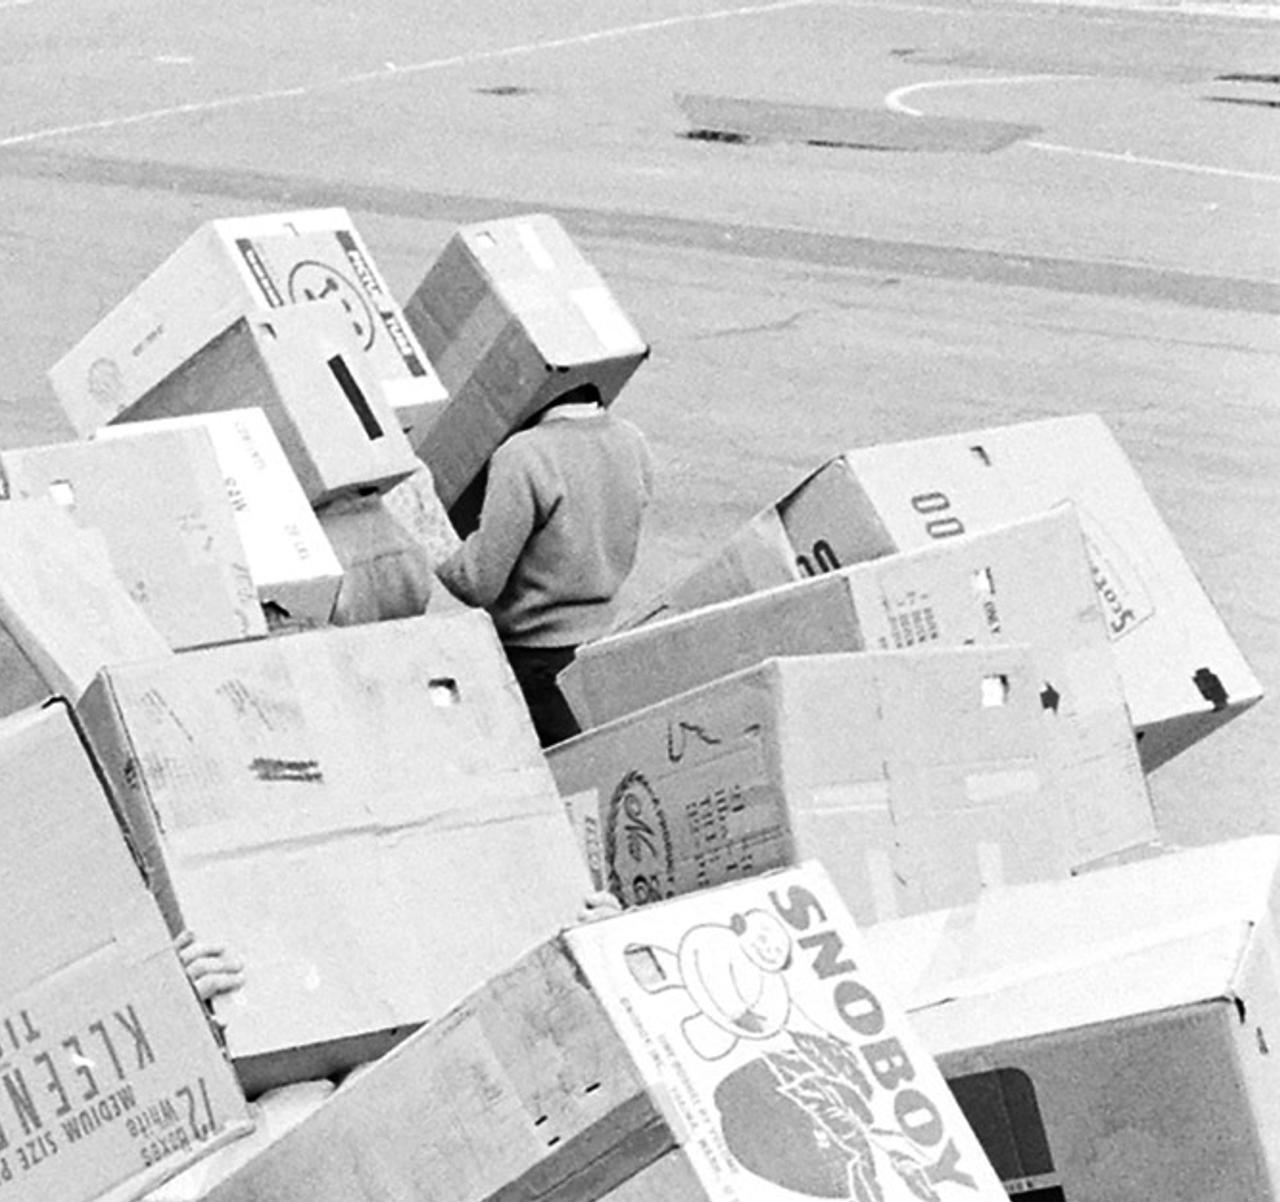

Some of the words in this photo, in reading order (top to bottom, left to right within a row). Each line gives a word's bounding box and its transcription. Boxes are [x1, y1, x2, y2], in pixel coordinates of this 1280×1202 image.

[767, 884, 979, 1193] SNOBOY
[61, 1088, 136, 1143] MEDIUM
[125, 1099, 179, 1138] White
[15, 1131, 58, 1171] SIZE
[140, 1126, 190, 1168] Boxes
